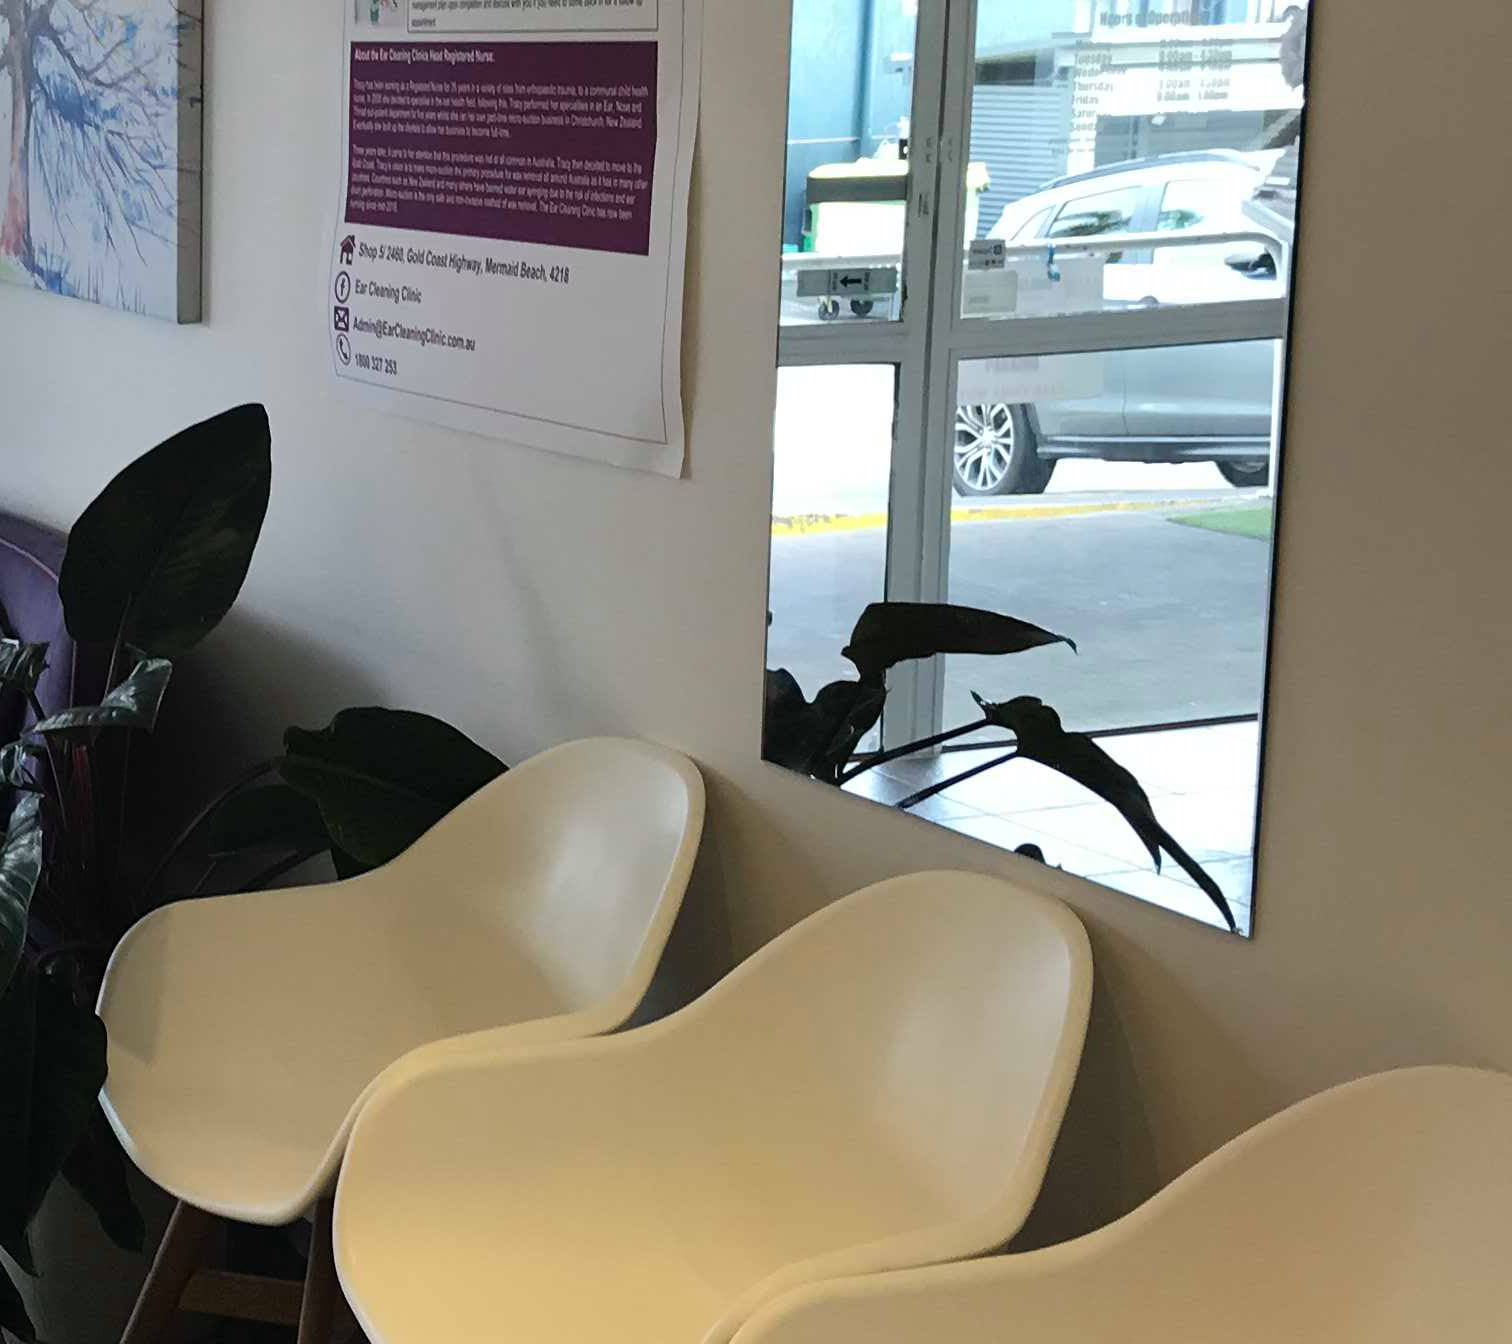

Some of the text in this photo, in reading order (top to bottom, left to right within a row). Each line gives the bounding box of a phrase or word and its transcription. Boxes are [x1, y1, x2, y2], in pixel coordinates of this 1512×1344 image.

[355, 48, 370, 60] About
[380, 48, 388, 60] Ear
[389, 49, 410, 64] Cleaning
[359, 242, 377, 261] Shop
[407, 247, 425, 264] Gold
[426, 250, 447, 267] Coast
[449, 253, 482, 275] Highway,
[486, 257, 519, 276] Mermaid
[520, 262, 547, 282] Beach,
[550, 265, 569, 284] 4218
[355, 279, 421, 304] Ear Cleaning Clinic
[353, 316, 475, 351] Admin@EarCleaningClinic.com.au
